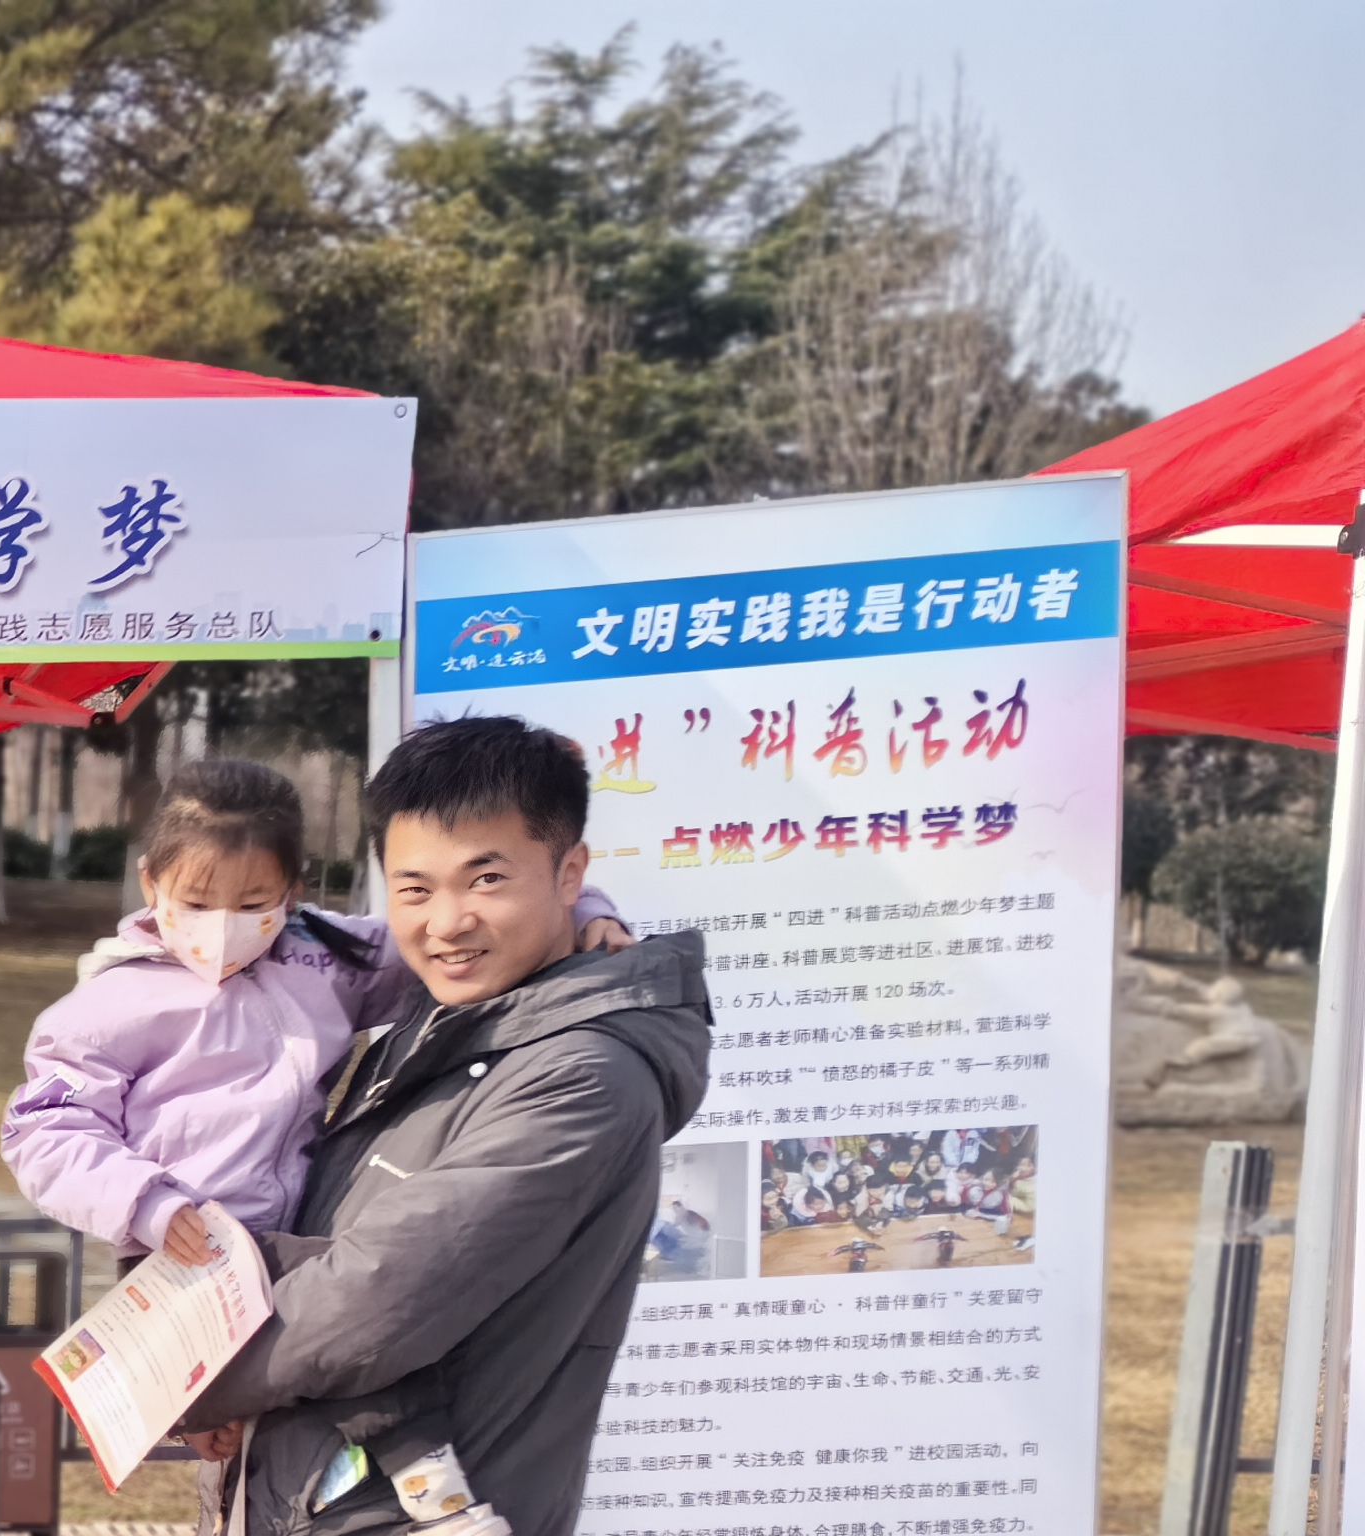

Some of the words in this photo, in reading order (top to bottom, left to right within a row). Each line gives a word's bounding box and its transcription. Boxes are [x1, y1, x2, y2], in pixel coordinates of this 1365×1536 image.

[572, 567, 1081, 659] 文明实践我是行动者
[617, 1325, 1042, 1361] 科普志愿者采用实体物件和现场情景相结合的方式
